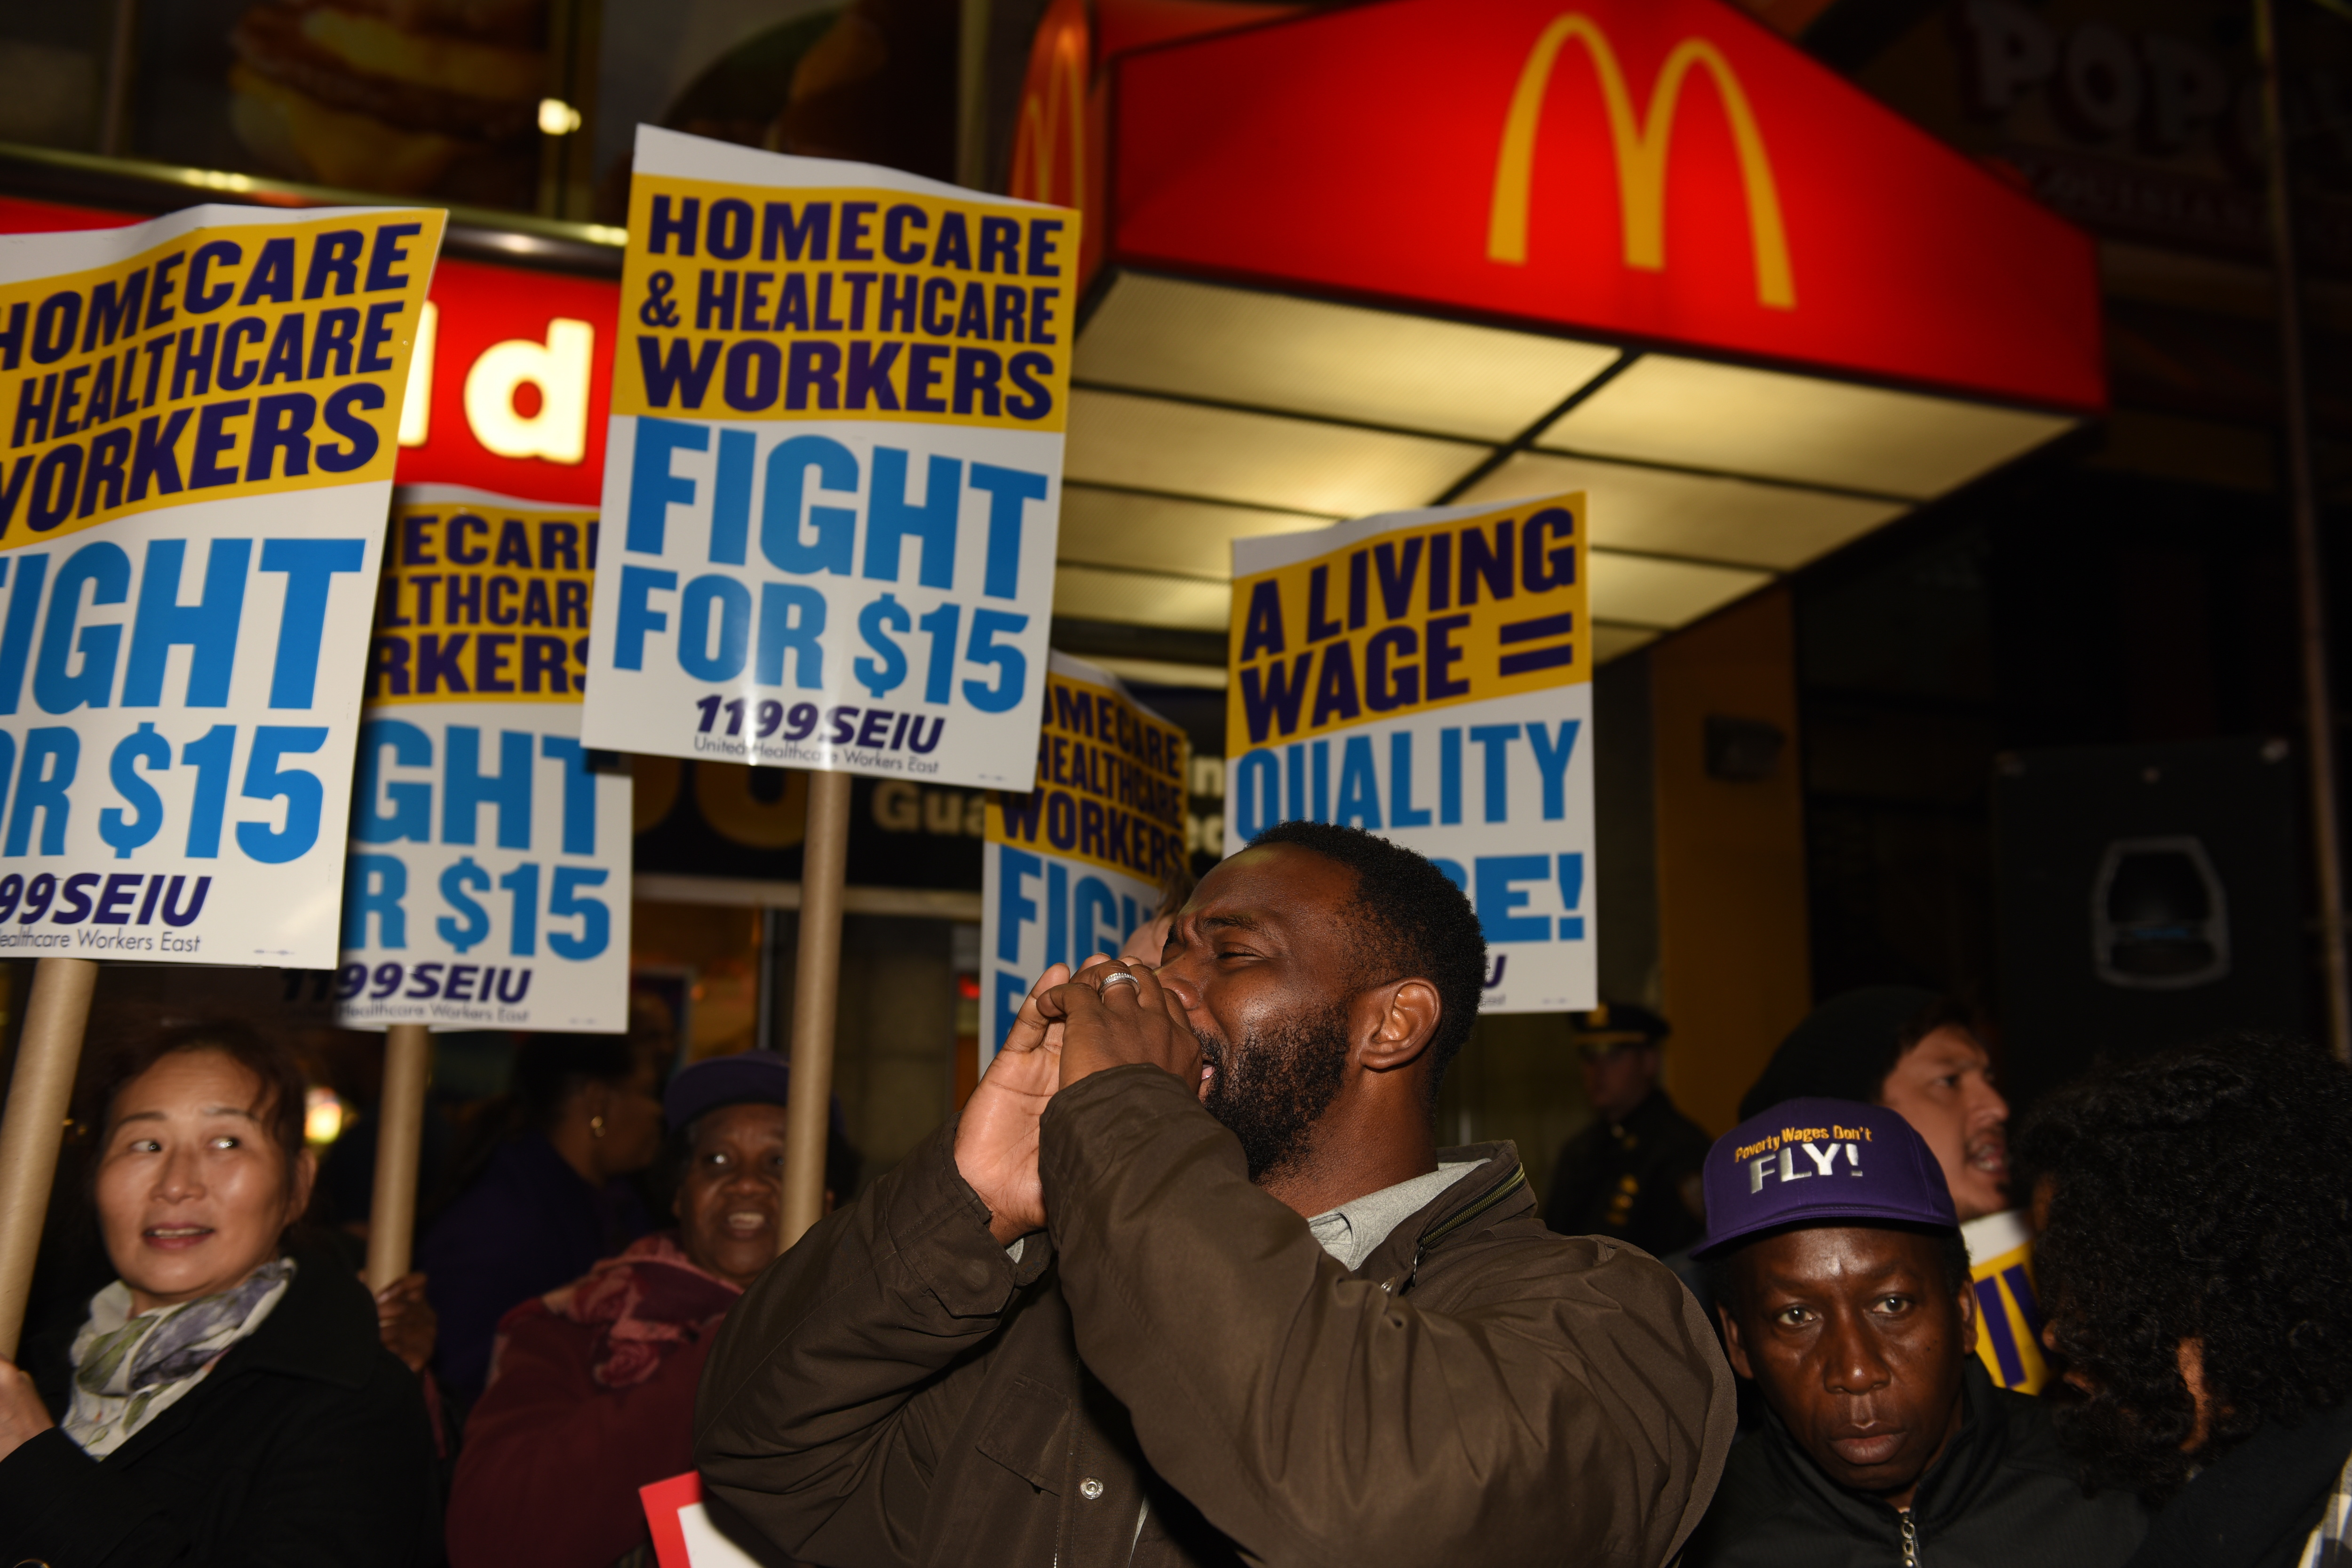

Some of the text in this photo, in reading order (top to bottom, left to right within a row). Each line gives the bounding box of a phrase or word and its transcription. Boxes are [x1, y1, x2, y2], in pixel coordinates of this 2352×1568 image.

[647, 194, 1065, 278] HOMECARE
[638, 269, 1060, 345] & HEALTHCARE
[10, 301, 405, 449] HEALTHCARE
[636, 334, 1055, 420] WORKERS
[625, 415, 1048, 601] FIGHT
[0, 538, 366, 715] IGHT
[1240, 506, 1576, 663] A LIVING
[612, 564, 1030, 714] FOR $15
[1239, 613, 1471, 744] WAGE
[98, 721, 330, 865] $15
[694, 735, 746, 756] United
[843, 748, 903, 772] Workers
[908, 756, 939, 774] East
[1235, 719, 1581, 843] QUALITY
[0, 925, 201, 953] ealthcare Workers East
[437, 856, 610, 961] $15
[431, 1003, 493, 1022] Workers
[1735, 1124, 1873, 1163] Poverty Wages Don't
[1749, 1143, 1863, 1194] FLY!
